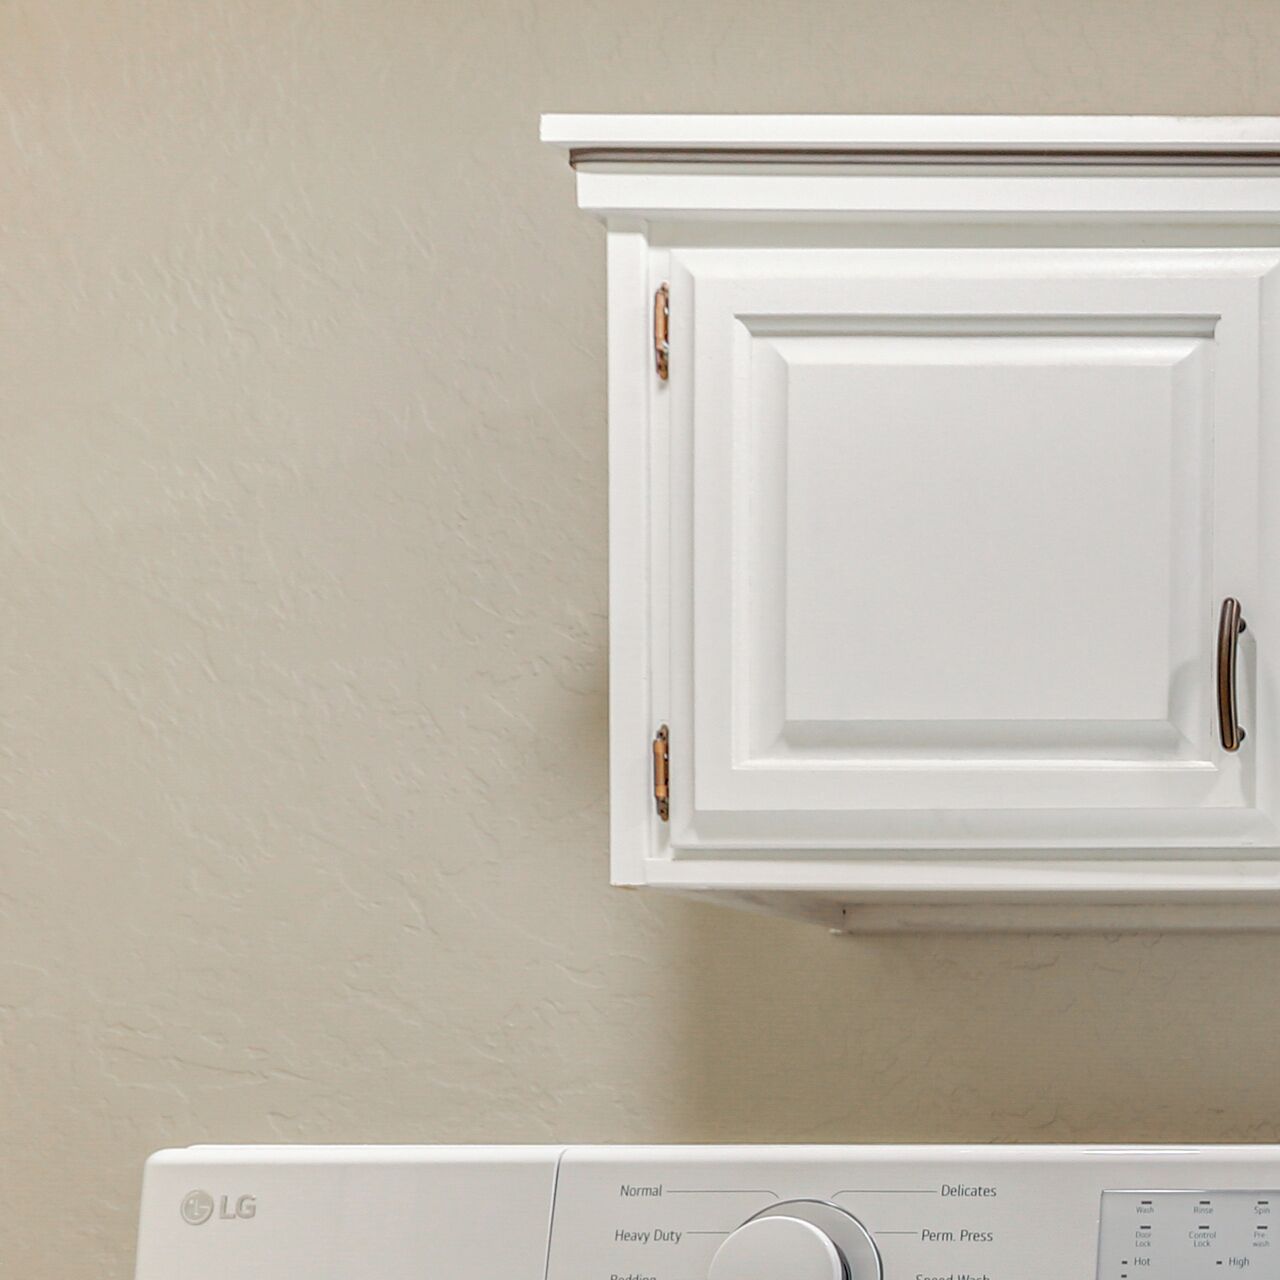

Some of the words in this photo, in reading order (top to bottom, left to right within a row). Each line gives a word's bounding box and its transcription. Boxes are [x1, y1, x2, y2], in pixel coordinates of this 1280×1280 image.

[620, 1184, 663, 1197] Normal
[941, 1184, 997, 1198] Delicates
[219, 1193, 257, 1220] LG
[1254, 1207, 1270, 1215] Spin
[614, 1229, 649, 1244] Heavy
[652, 1229, 682, 1244] Duty
[921, 1229, 956, 1242] Perm.
[960, 1229, 994, 1242] Press
[1134, 1257, 1150, 1266] Hot
[1228, 1257, 1249, 1268] High
